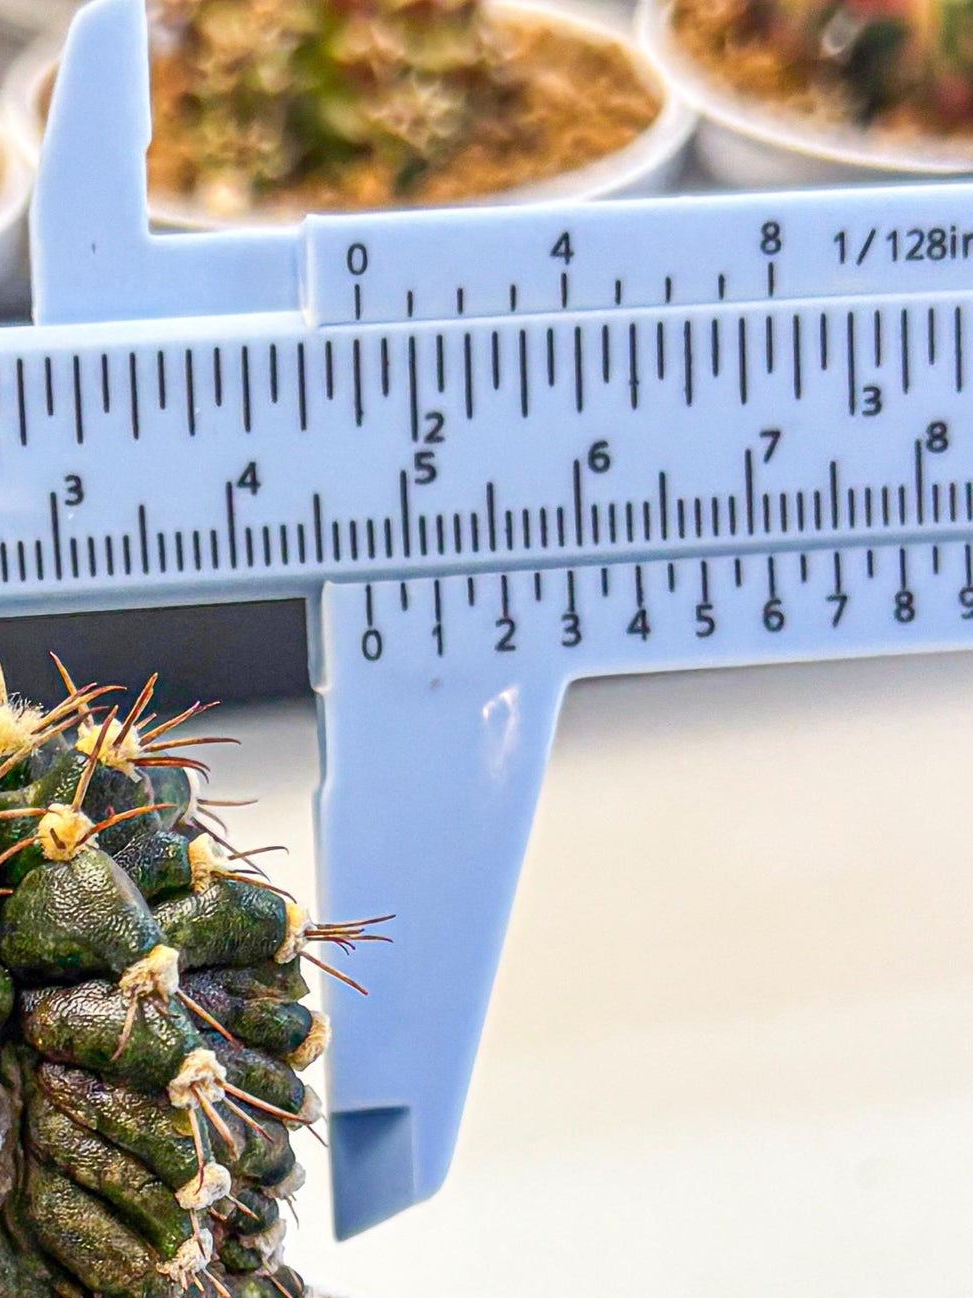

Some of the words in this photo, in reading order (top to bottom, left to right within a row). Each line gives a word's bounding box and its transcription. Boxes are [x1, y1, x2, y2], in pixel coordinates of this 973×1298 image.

[345, 242, 369, 276] 0
[550, 231, 575, 266] 4
[759, 220, 783, 256] 8
[424, 411, 446, 445] 2
[861, 386, 884, 417] 3
[63, 473, 85, 507] 3
[236, 461, 262, 497] 4
[413, 450, 438, 485] 5
[586, 440, 612, 474] 6
[758, 429, 783, 464] 7
[926, 421, 949, 454] 8
[360, 629, 384, 662] 0
[429, 624, 444, 657] 1
[494, 618, 518, 653] 2
[560, 613, 583, 648] 3
[626, 609, 651, 641] 4
[694, 604, 716, 639] 5
[762, 600, 786, 633] 6
[825, 594, 849, 628] 7
[893, 590, 916, 623] 8
